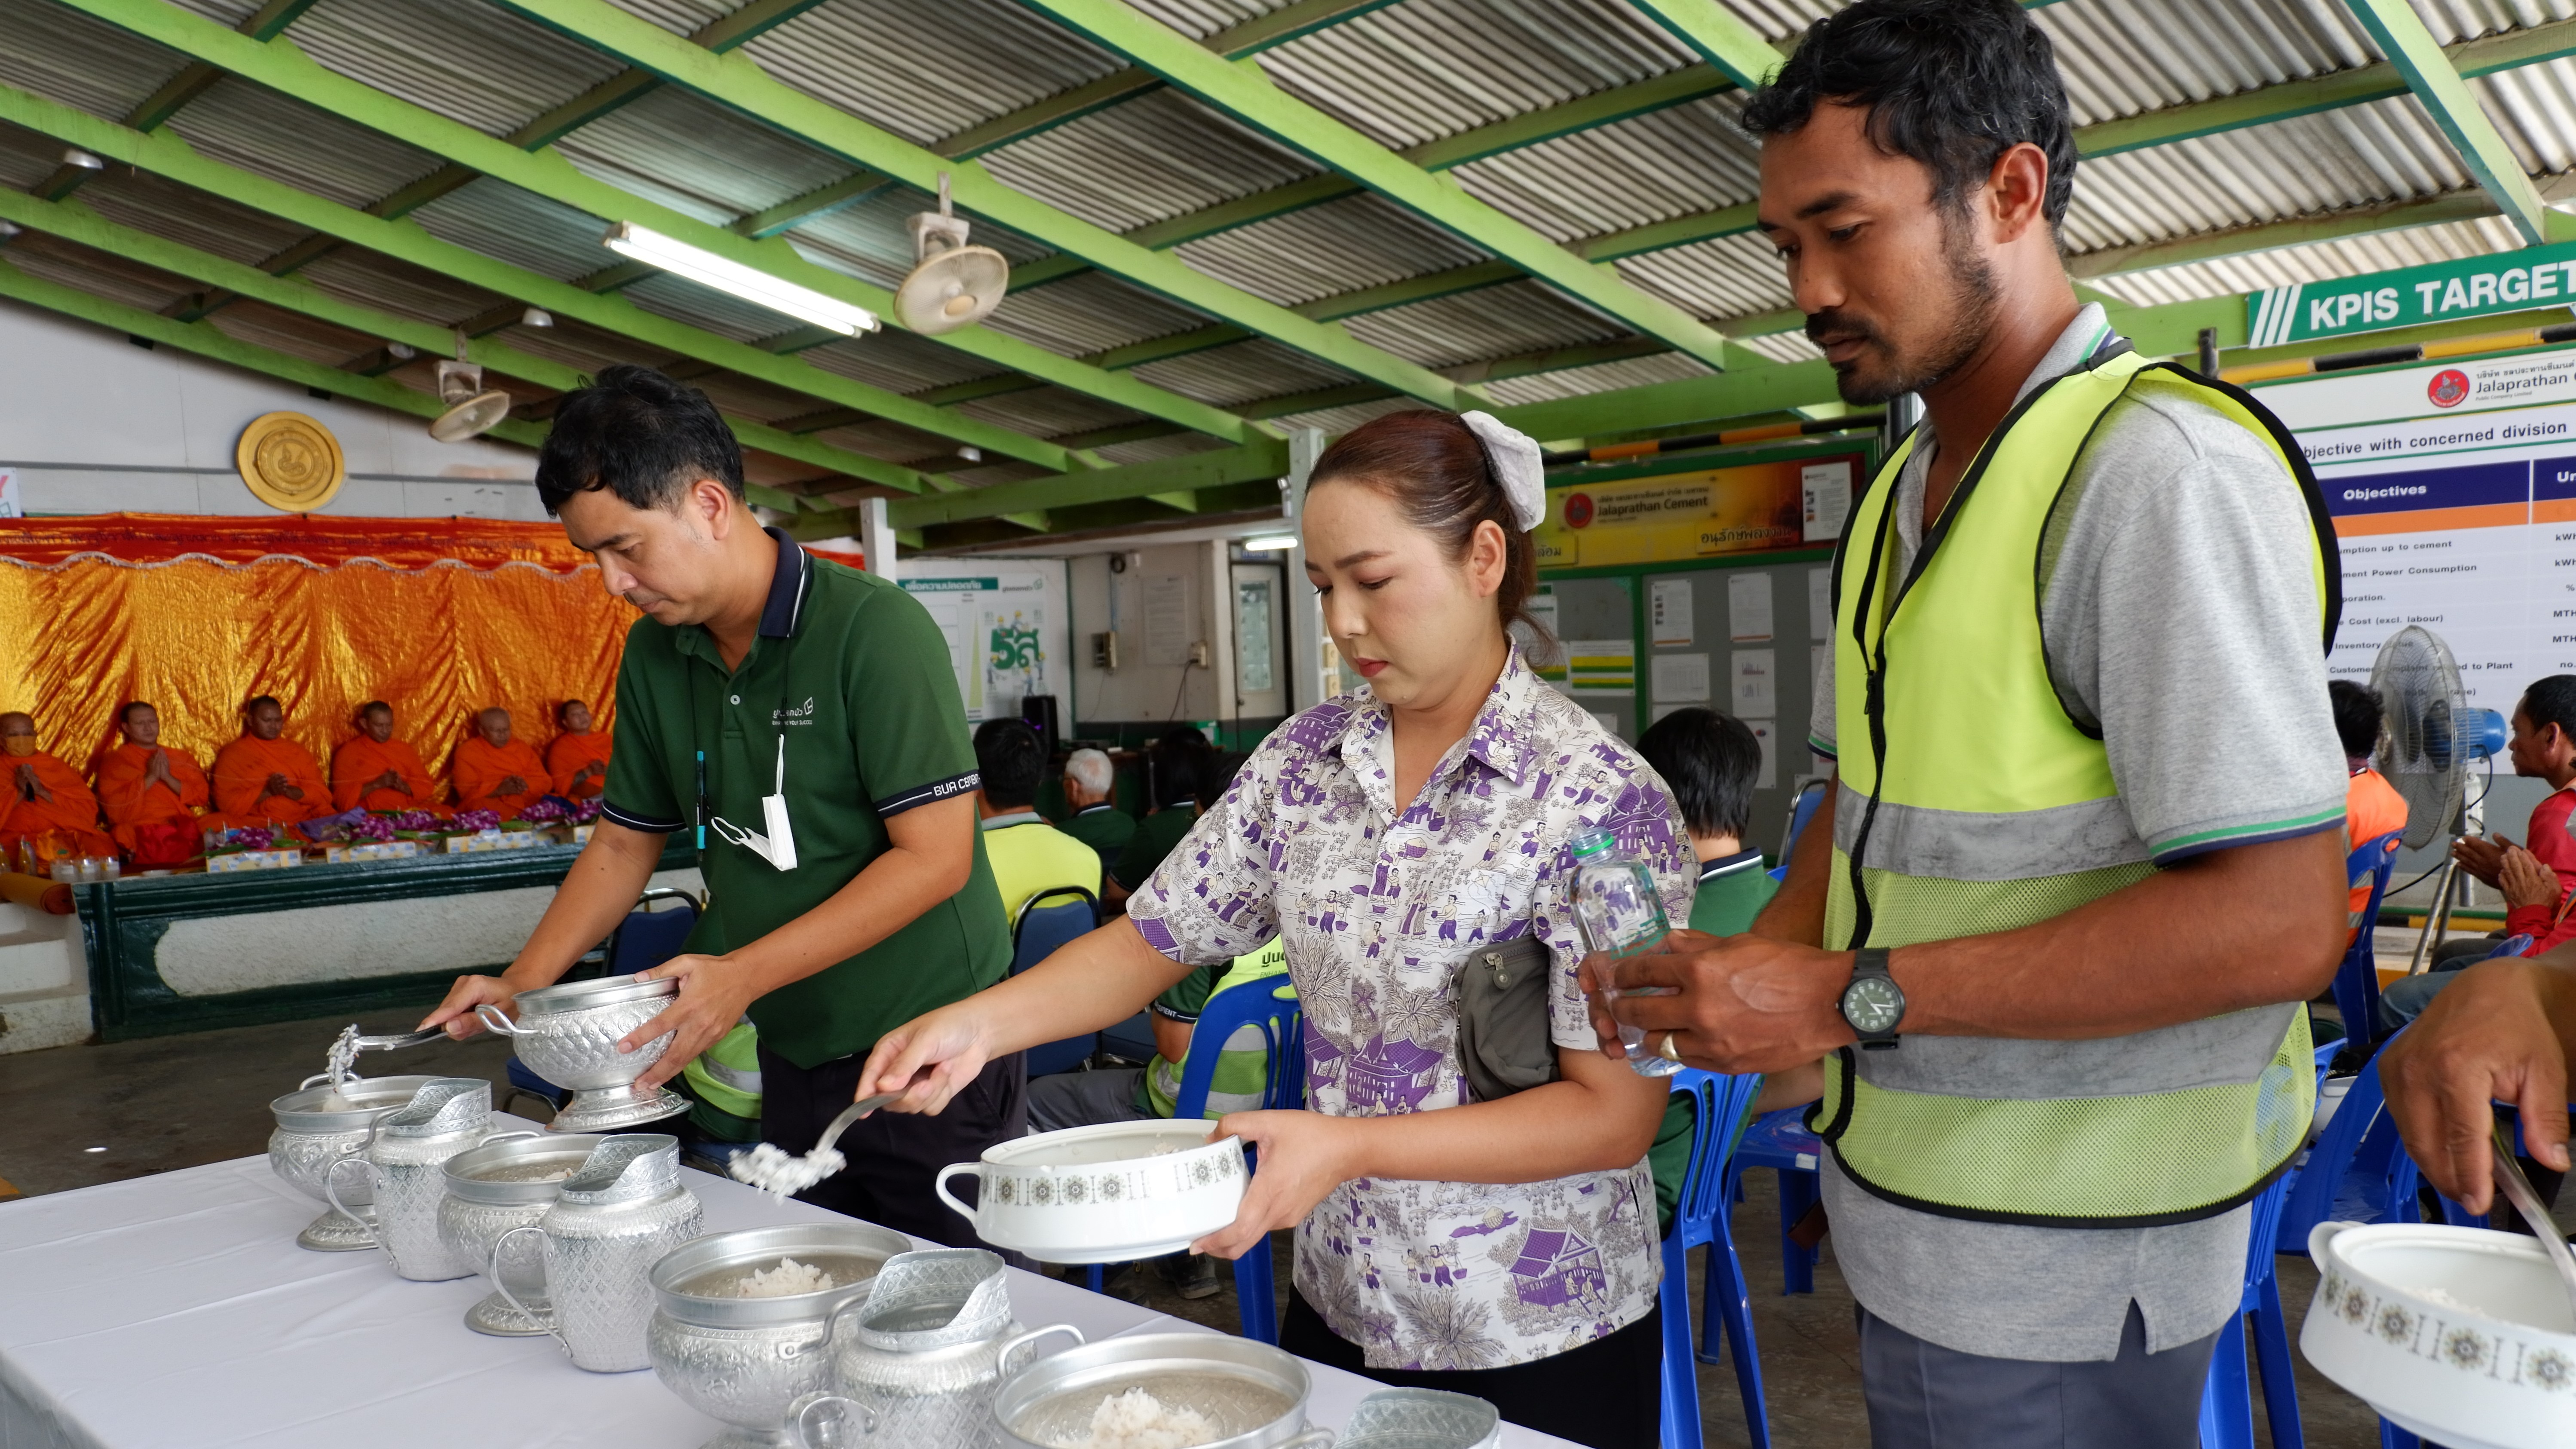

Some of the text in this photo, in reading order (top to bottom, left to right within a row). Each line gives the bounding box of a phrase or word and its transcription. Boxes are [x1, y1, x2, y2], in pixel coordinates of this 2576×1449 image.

[2311, 260, 2576, 330] KPIS TARGET
[2476, 374, 2567, 393] Jalaprathan
[2304, 422, 2567, 459] bjective with concerned division
[2343, 484, 2427, 500] Objectives
[1598, 496, 1708, 516] Jalaprathan Cement
[2339, 545, 2377, 554] mption
[2413, 541, 2452, 549] cement
[2408, 564, 2477, 574] Consumption
[2342, 594, 2386, 603] poration.
[2376, 616, 2402, 625] (excl.
[2407, 615, 2443, 623] labour)
[933, 774, 979, 796] BUA CEMENT
